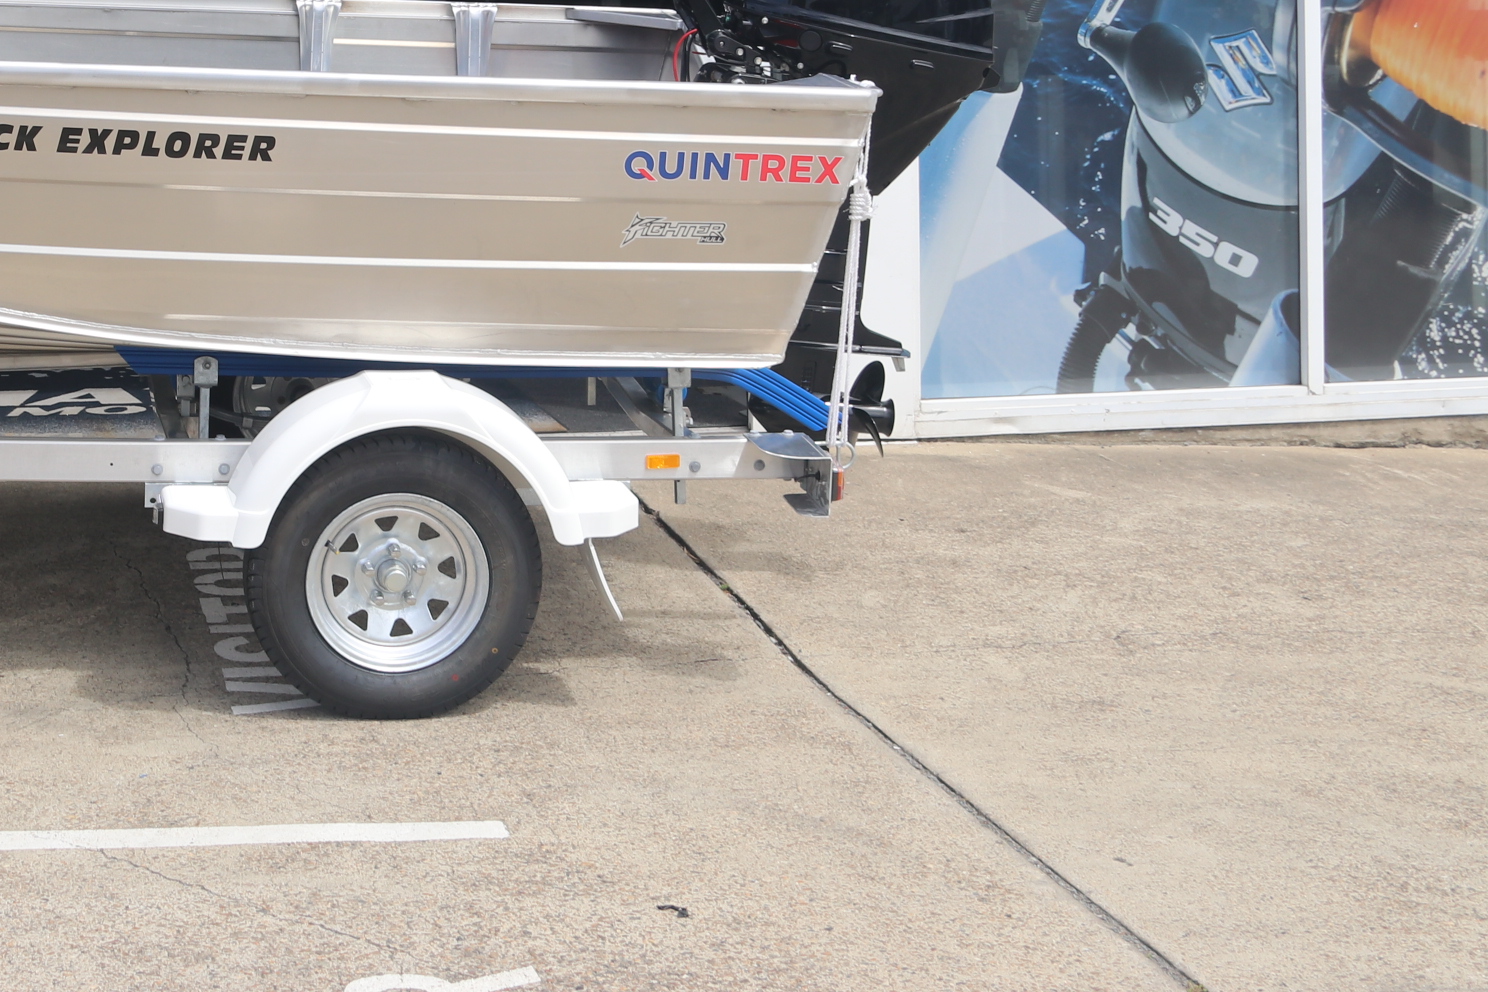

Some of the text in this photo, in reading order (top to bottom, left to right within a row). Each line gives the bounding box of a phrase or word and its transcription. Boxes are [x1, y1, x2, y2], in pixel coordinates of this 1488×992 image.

[55, 126, 277, 162] EXPLORER
[624, 150, 845, 186] QUINTREX
[1148, 196, 1260, 279] 350
[7, 404, 157, 418] MO
